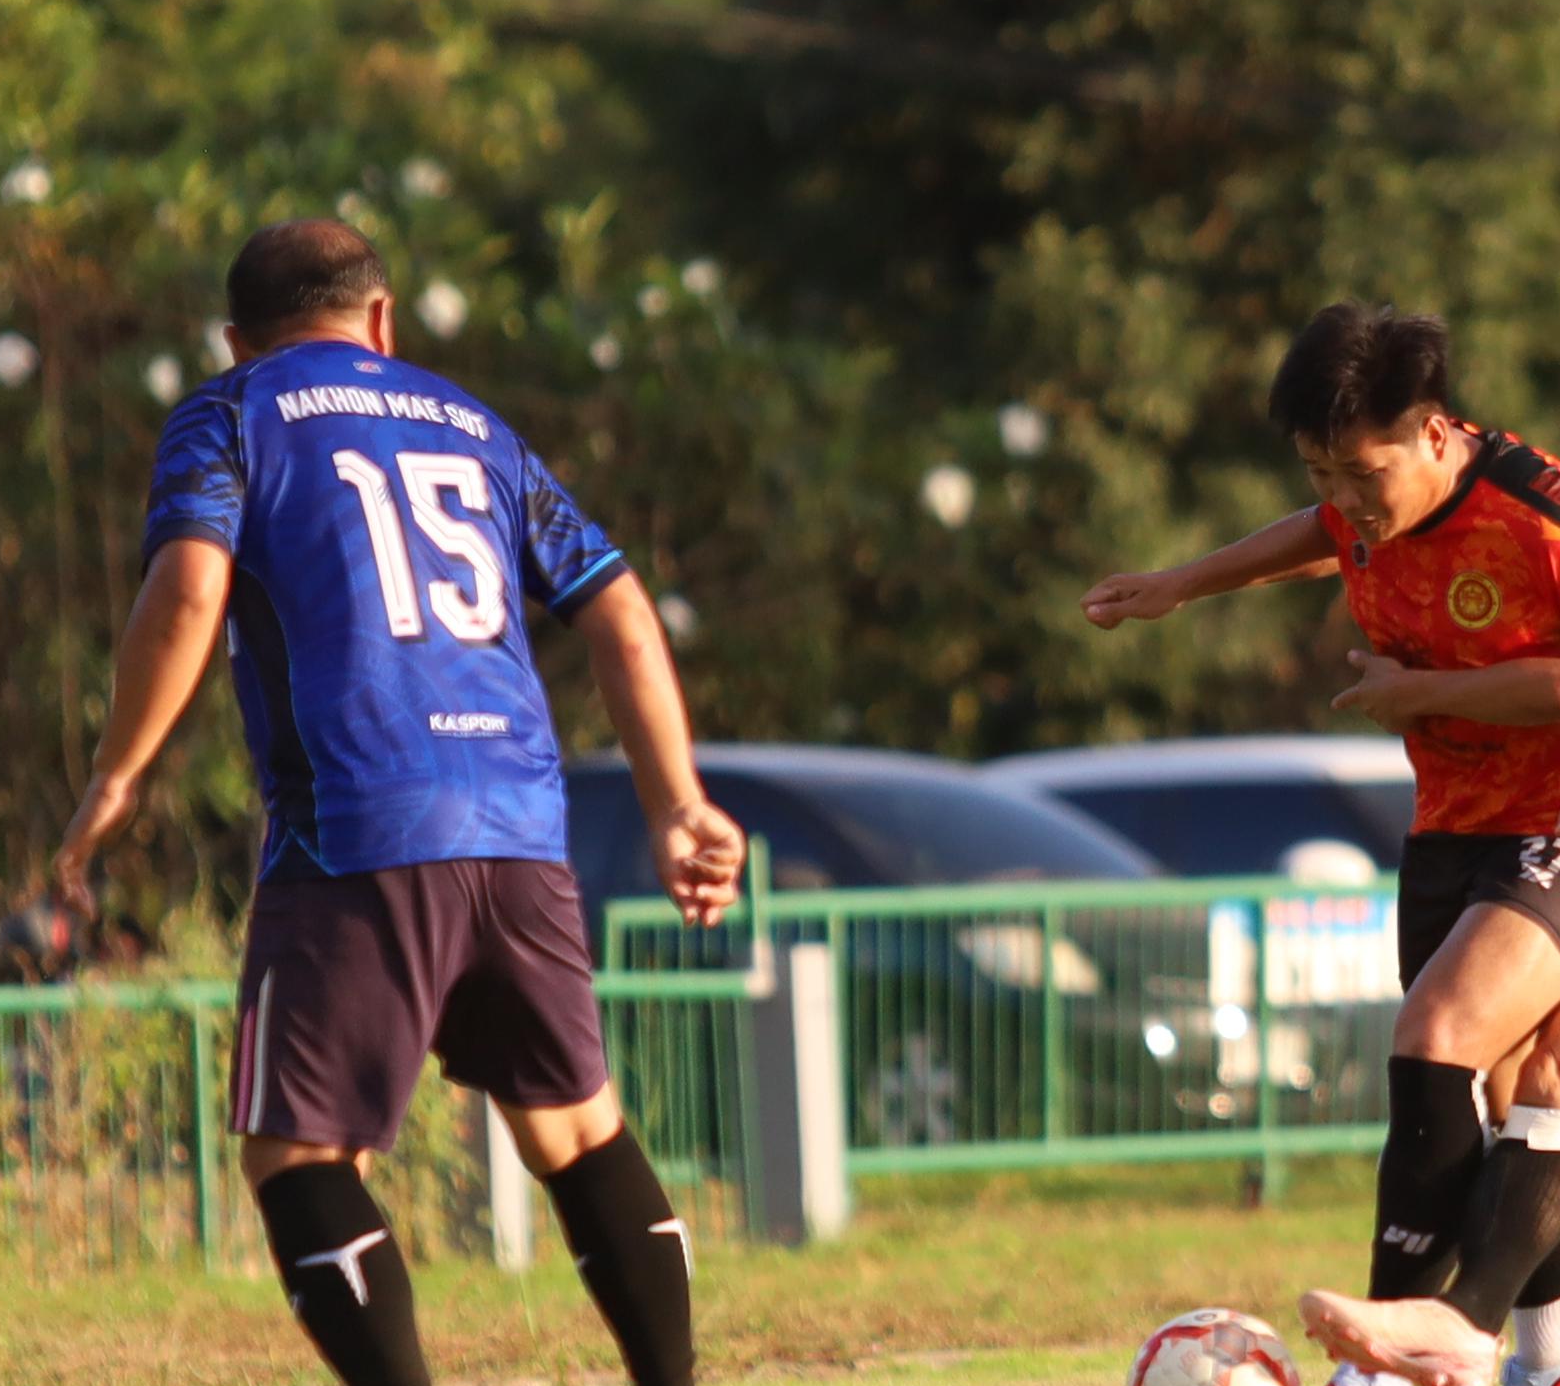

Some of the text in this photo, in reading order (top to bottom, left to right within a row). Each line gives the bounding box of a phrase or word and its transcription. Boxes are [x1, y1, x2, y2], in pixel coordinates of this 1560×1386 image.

[276, 385, 489, 441] NAKHON MAE SOT
[332, 449, 507, 640] 15
